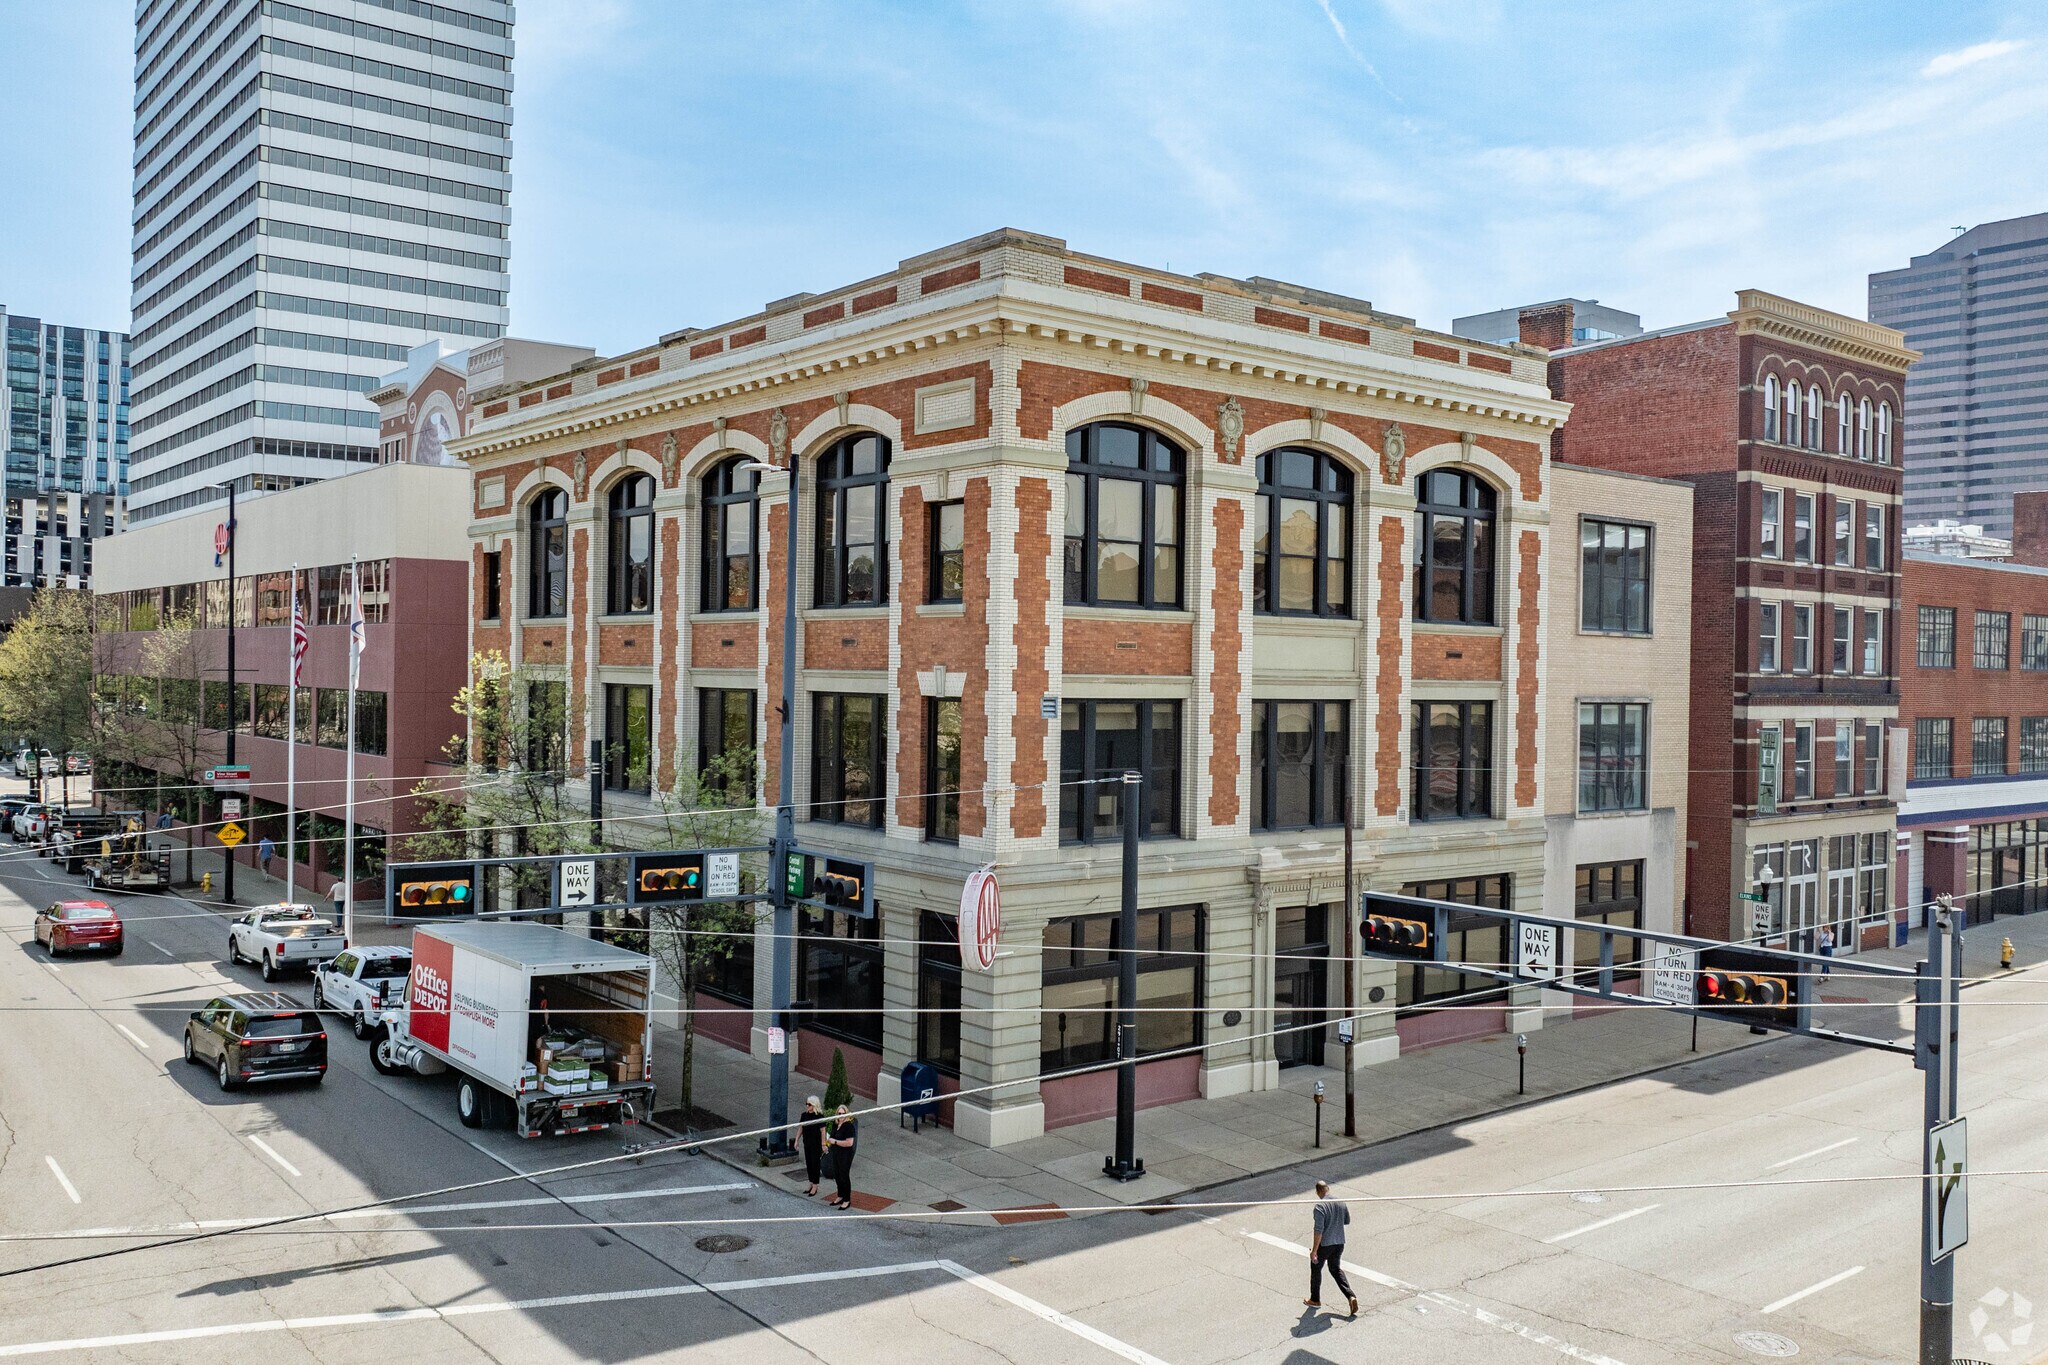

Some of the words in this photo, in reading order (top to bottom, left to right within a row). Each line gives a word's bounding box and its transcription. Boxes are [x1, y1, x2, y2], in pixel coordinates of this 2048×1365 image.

[1762, 749, 1775, 765] H
[1761, 768, 1773, 783] L
[719, 856, 728, 864] NO
[566, 865, 589, 875] ONE
[567, 877, 590, 887] WAY
[1755, 905, 1770, 914] ONE
[1755, 913, 1770, 921] WAY
[1525, 927, 1549, 942] ONE
[1524, 942, 1550, 957] WAY
[1669, 947, 1682, 957] NO
[1663, 957, 1687, 969] TURN
[415, 963, 448, 997] Office
[1657, 968, 1669, 978] ON
[1673, 971, 1691, 982] RED
[414, 986, 448, 1016] DEPOT
[454, 992, 472, 1007] HELPING
[1656, 989, 1676, 999] SCHOOL
[1677, 992, 1690, 1001] DAYS
[482, 1015, 496, 1030] MORE
